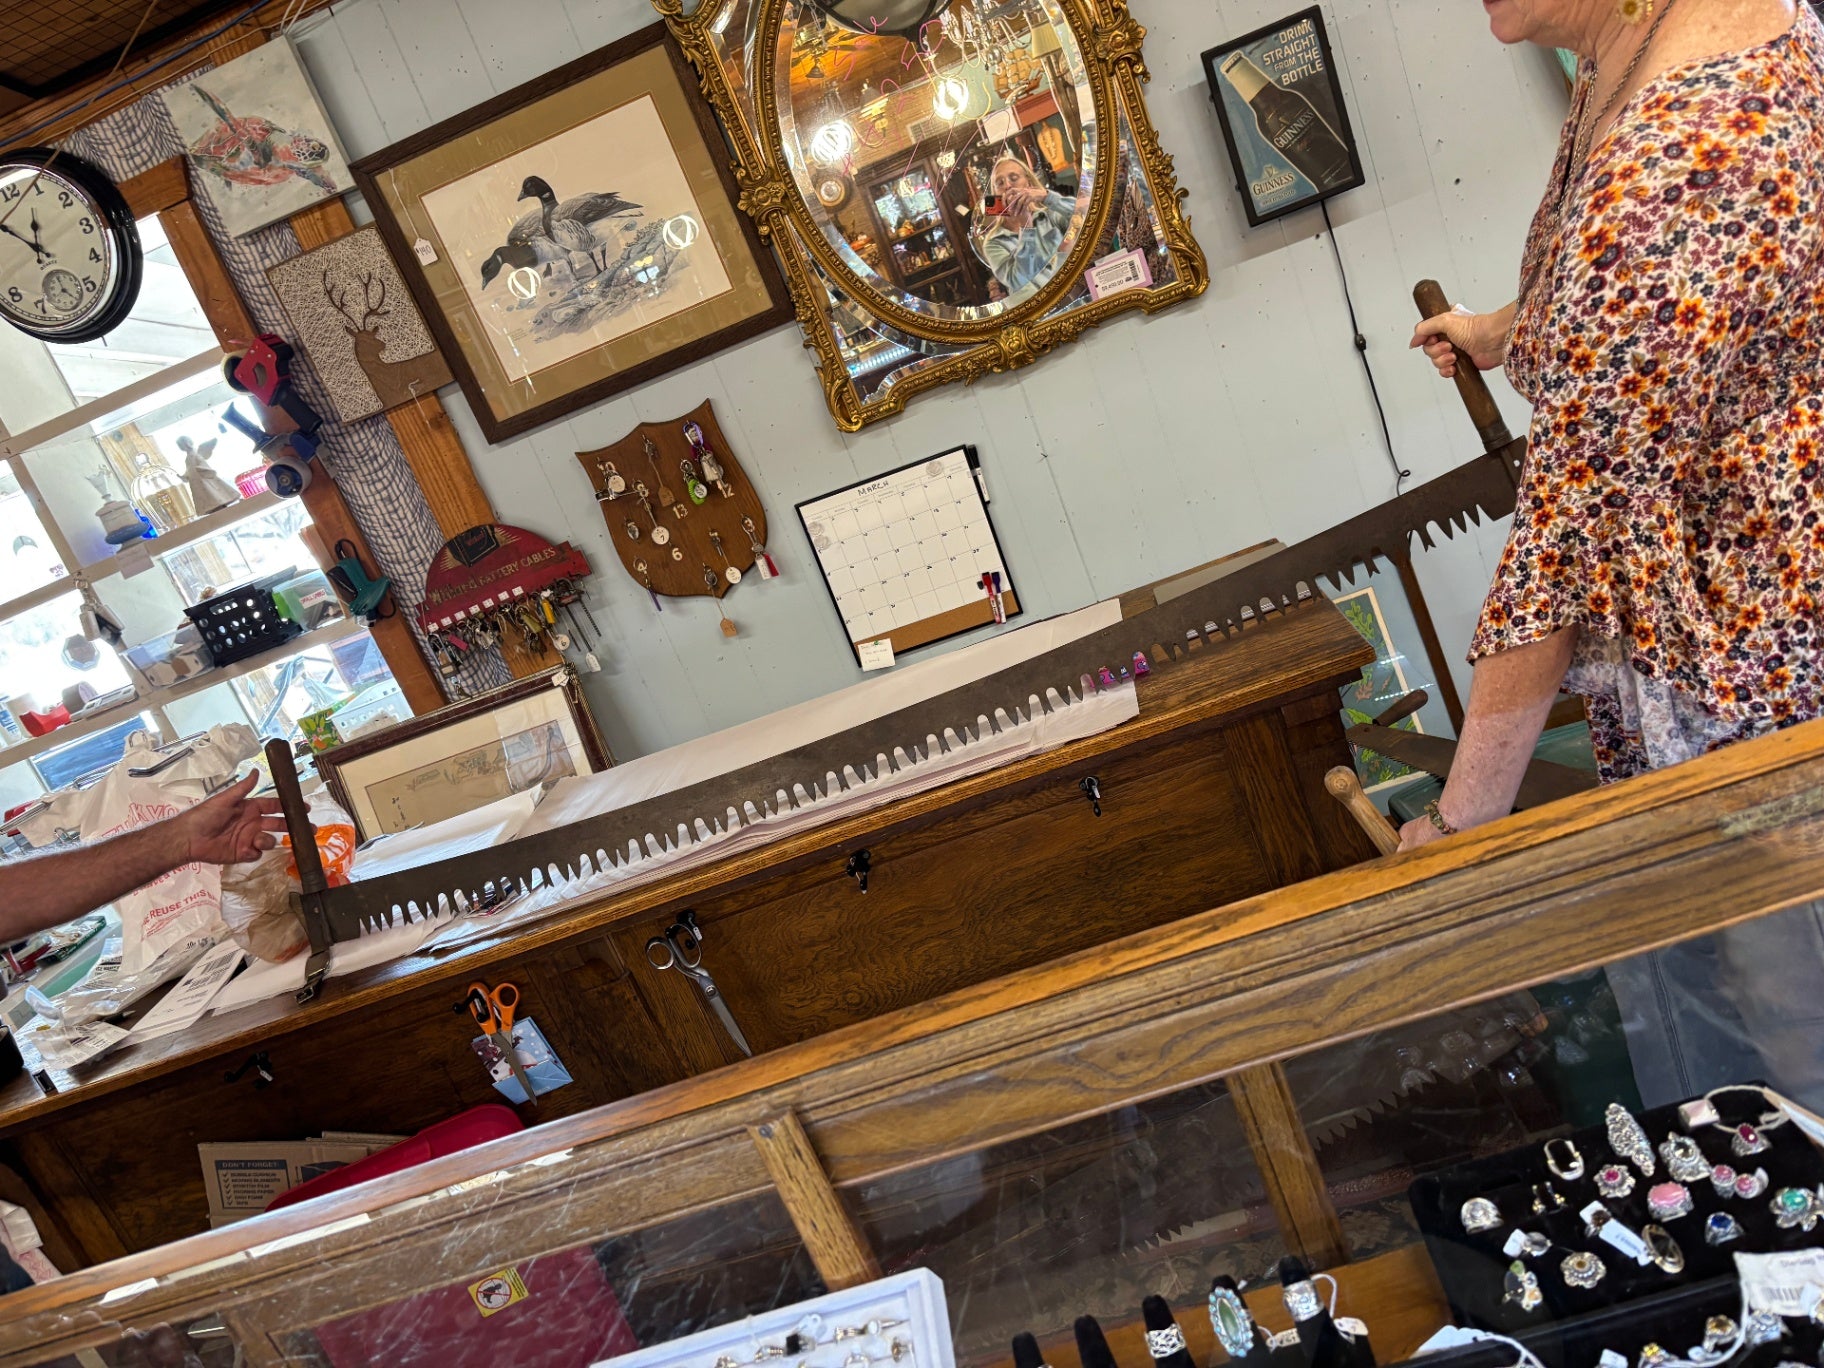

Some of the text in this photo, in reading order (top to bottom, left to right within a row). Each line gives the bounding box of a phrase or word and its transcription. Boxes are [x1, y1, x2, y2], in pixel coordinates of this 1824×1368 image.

[1279, 20, 1312, 44] DRINK
[1263, 34, 1315, 66] STRAIGHT
[1274, 46, 1321, 72] FROM THE
[1281, 58, 1324, 86] BOTTLE
[1273, 111, 1314, 149] GUINNESS
[34, 180, 45, 197] 1
[1253, 172, 1295, 196] GUINNESS
[58, 191, 74, 209] 2
[79, 216, 95, 235] 3
[88, 247, 103, 264] 4
[82, 275, 97, 293] 5
[8, 286, 23, 303] 8
[34, 297, 48, 315] 7
[857, 480, 889, 497] MARCH
[672, 503, 689, 520] 13
[520, 547, 556, 568] CABLES
[671, 547, 683, 562] 6
[149, 901, 182, 919] REUSE
[184, 888, 207, 905] THIS
[222, 1161, 245, 1169] DON'T
